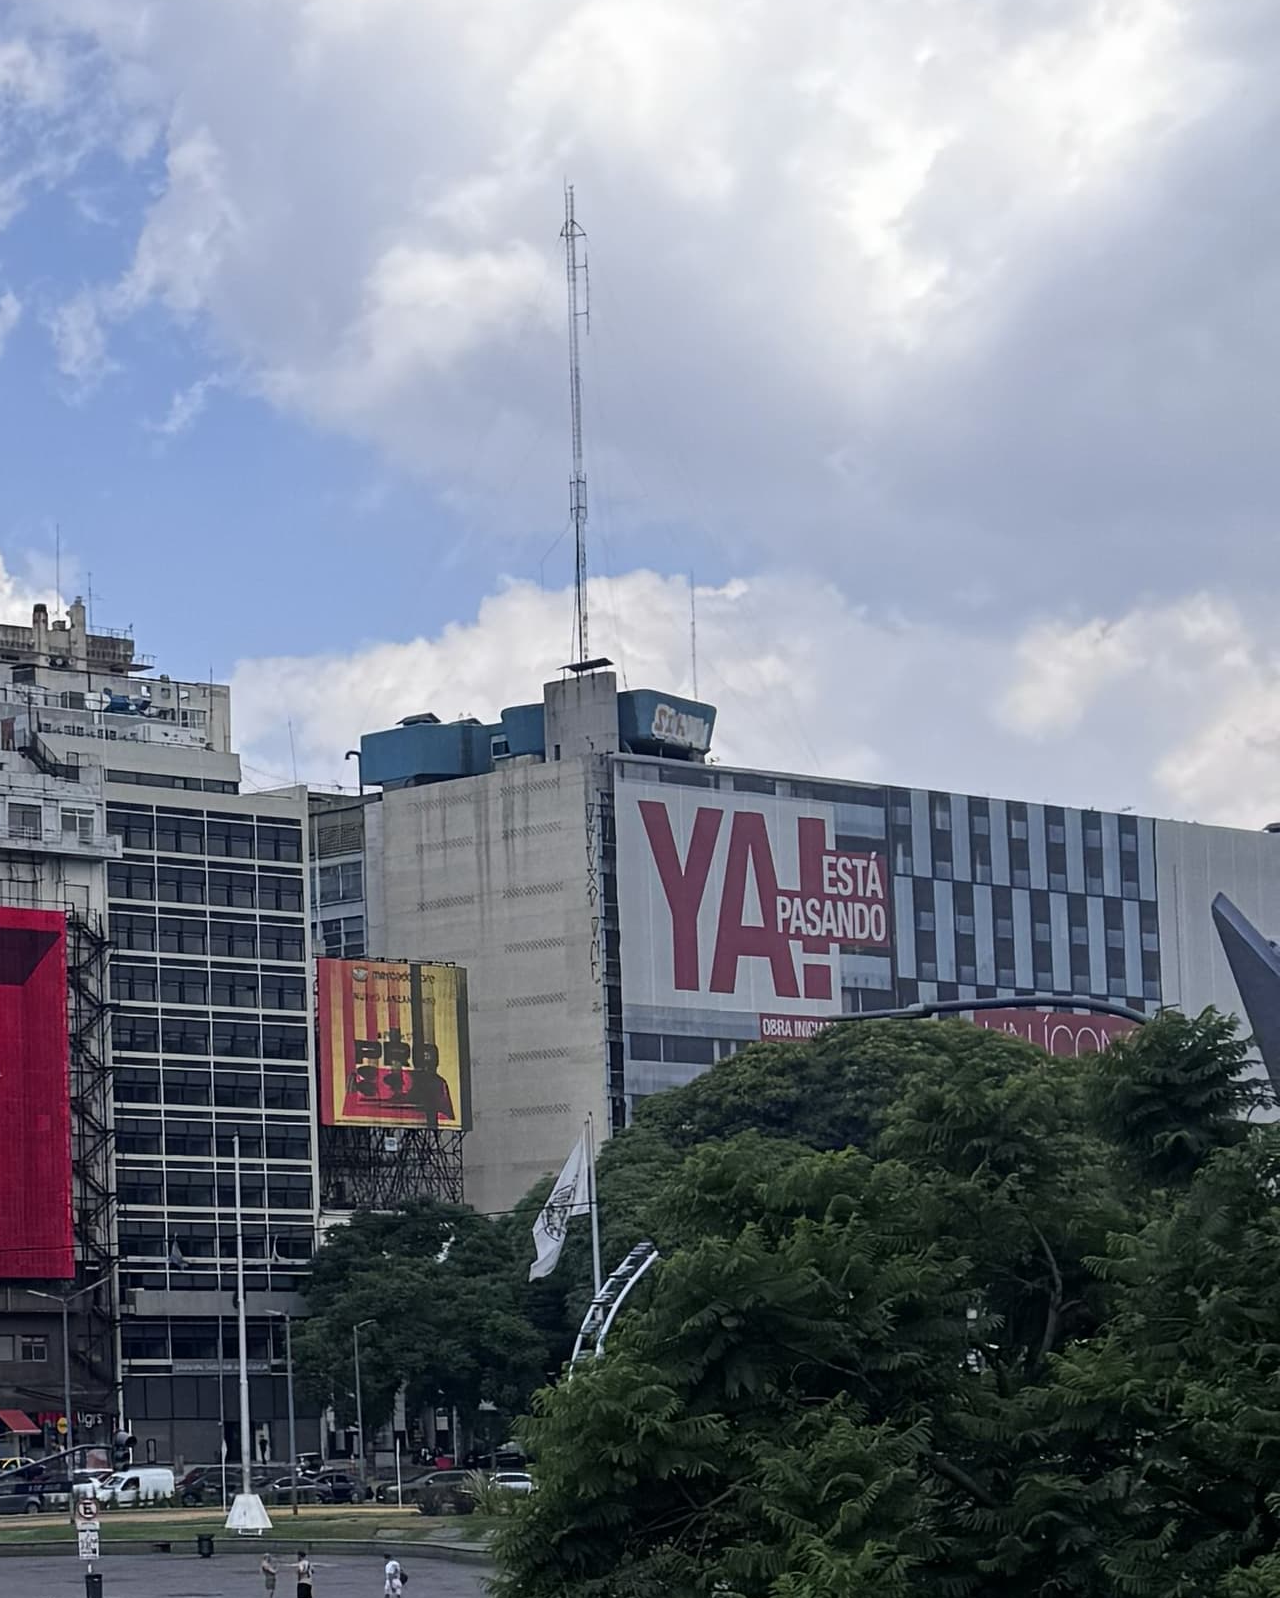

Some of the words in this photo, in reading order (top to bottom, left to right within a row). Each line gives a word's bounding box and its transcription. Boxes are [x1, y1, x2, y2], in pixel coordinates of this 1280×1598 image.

[822, 852, 883, 899] ESTÁ
[637, 800, 833, 1001] YA!
[776, 896, 886, 942] PASANDO
[762, 1017, 792, 1037] OBRA
